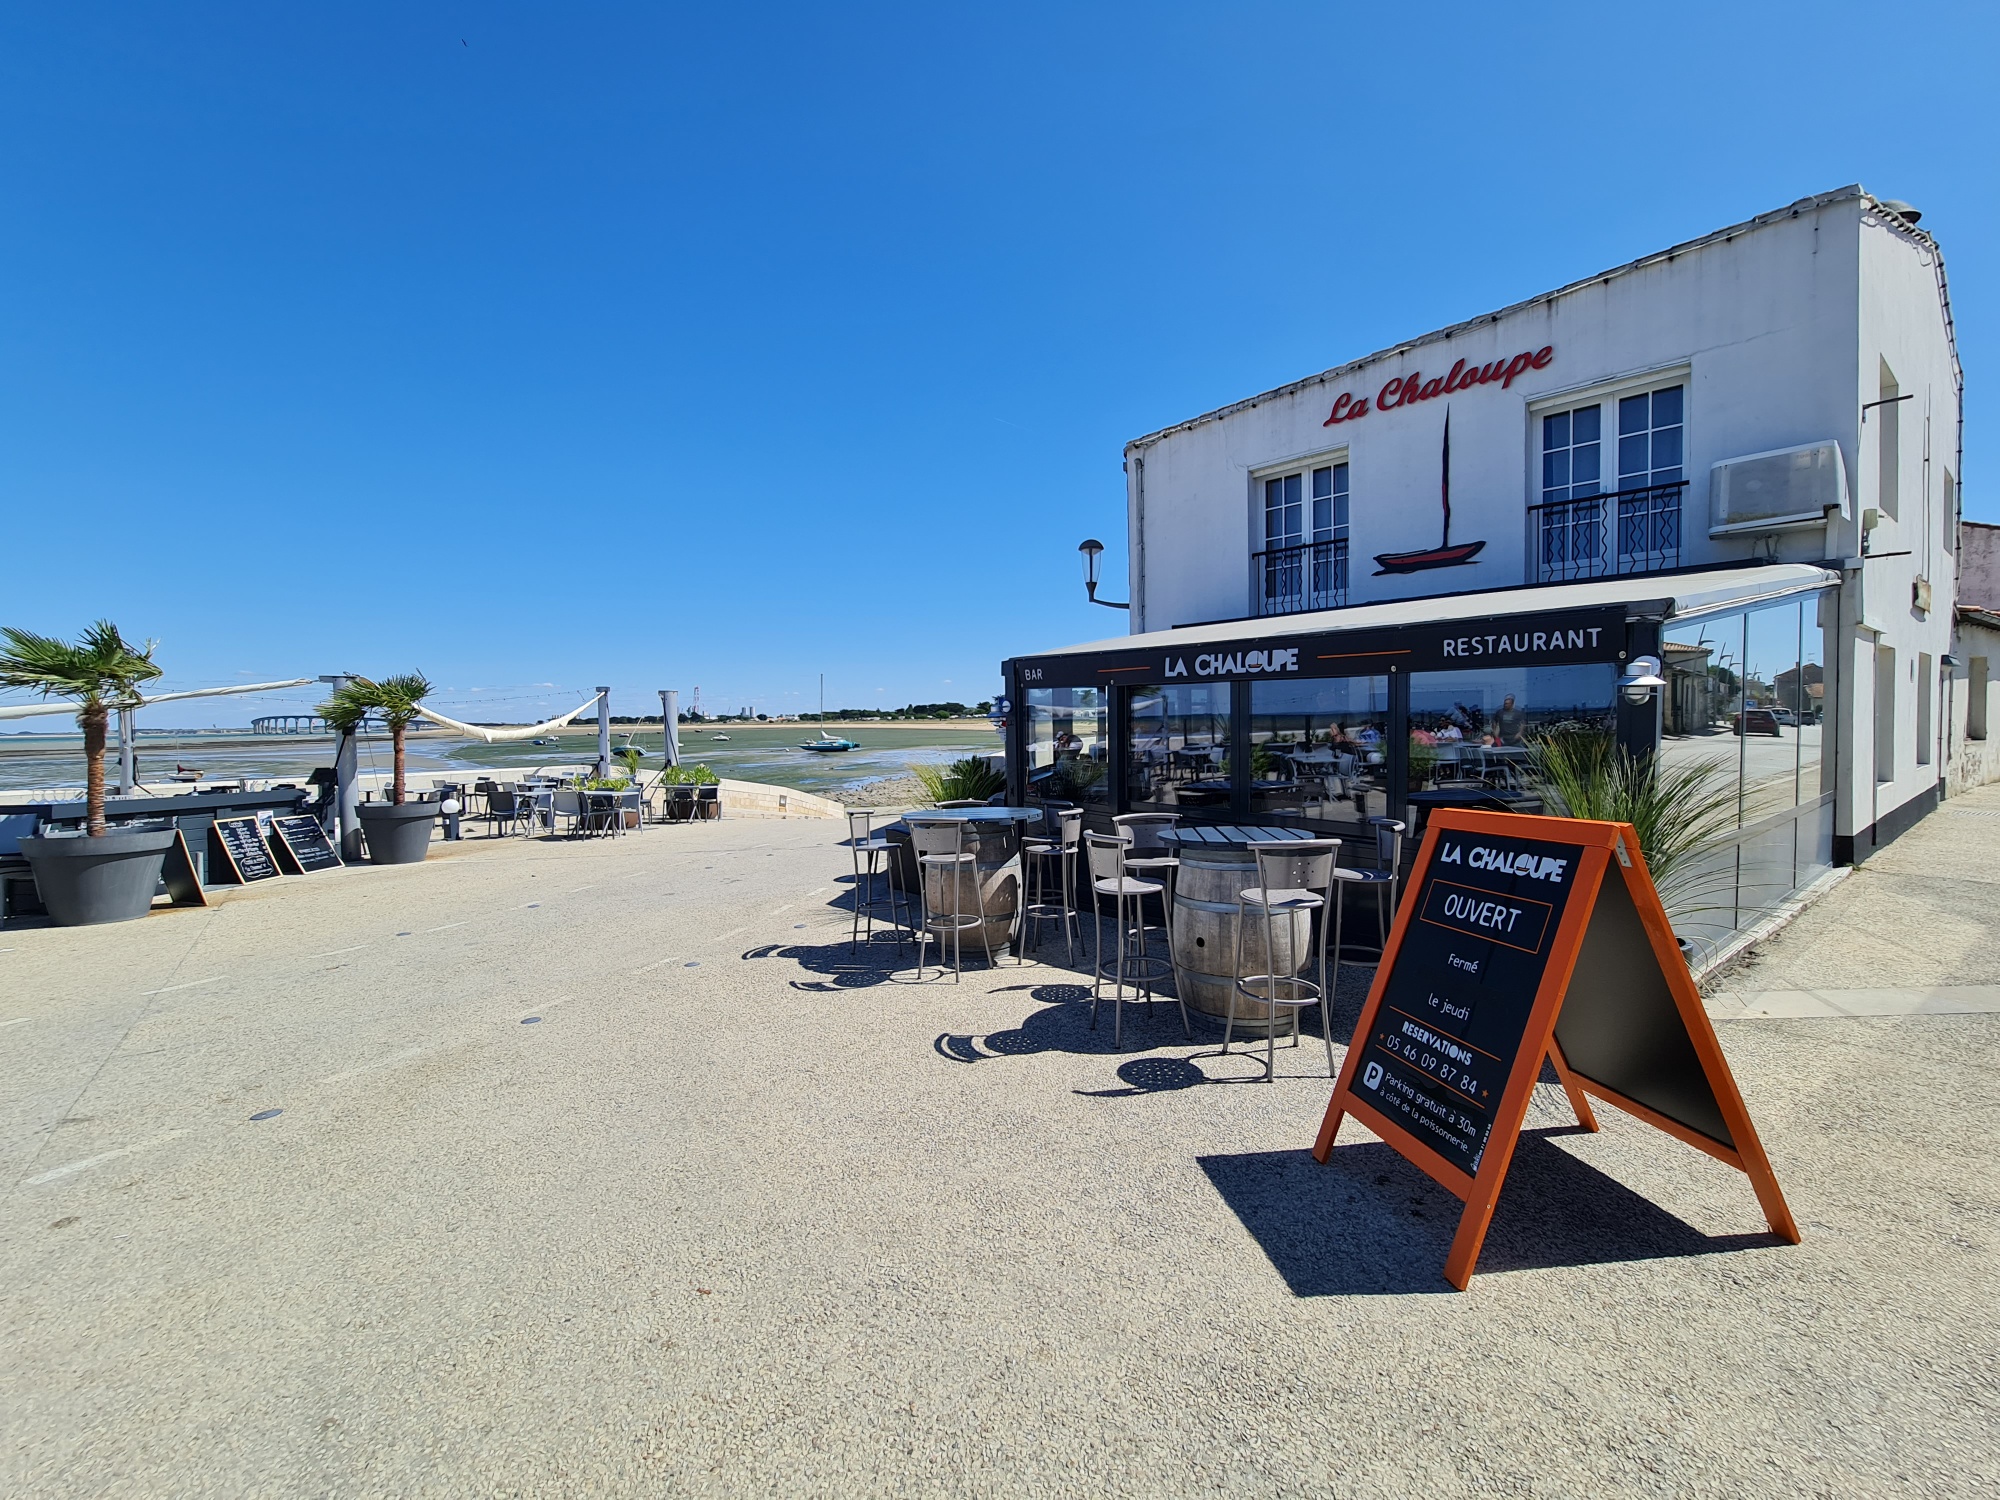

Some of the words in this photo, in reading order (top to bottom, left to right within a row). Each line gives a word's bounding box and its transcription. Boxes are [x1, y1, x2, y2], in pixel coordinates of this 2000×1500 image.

[1323, 392, 1369, 427] La
[1376, 345, 1553, 411] Chaloupe
[1443, 627, 1603, 657] RESTAURANT
[1024, 668, 1043, 681] BAR
[1164, 656, 1188, 677] LA
[1194, 648, 1299, 676] CHALOUPE
[1440, 842, 1461, 865] LA
[1468, 846, 1568, 883] CHALOUPE
[1444, 893, 1522, 933] OUVERT
[1447, 953, 1480, 973] Fermé
[1428, 992, 1439, 1007] le
[1440, 998, 1471, 1021] jeudi
[1401, 1020, 1473, 1066] RESERVATIONS
[1386, 1034, 1401, 1051] 05
[1403, 1044, 1417, 1061] 46
[1420, 1053, 1437, 1071] 09
[1440, 1063, 1457, 1082] 87
[1460, 1074, 1478, 1095] 84
[1379, 1086, 1385, 1097] à
[1385, 1092, 1401, 1107] côté
[1401, 1102, 1411, 1113] de
[1411, 1107, 1419, 1119] la
[1419, 1115, 1469, 1154] poissonnerie.
[1384, 1072, 1415, 1099] Parking
[1416, 1093, 1447, 1119] gratuit
[1448, 1110, 1457, 1123] à
[1457, 1115, 1476, 1138] 30m
